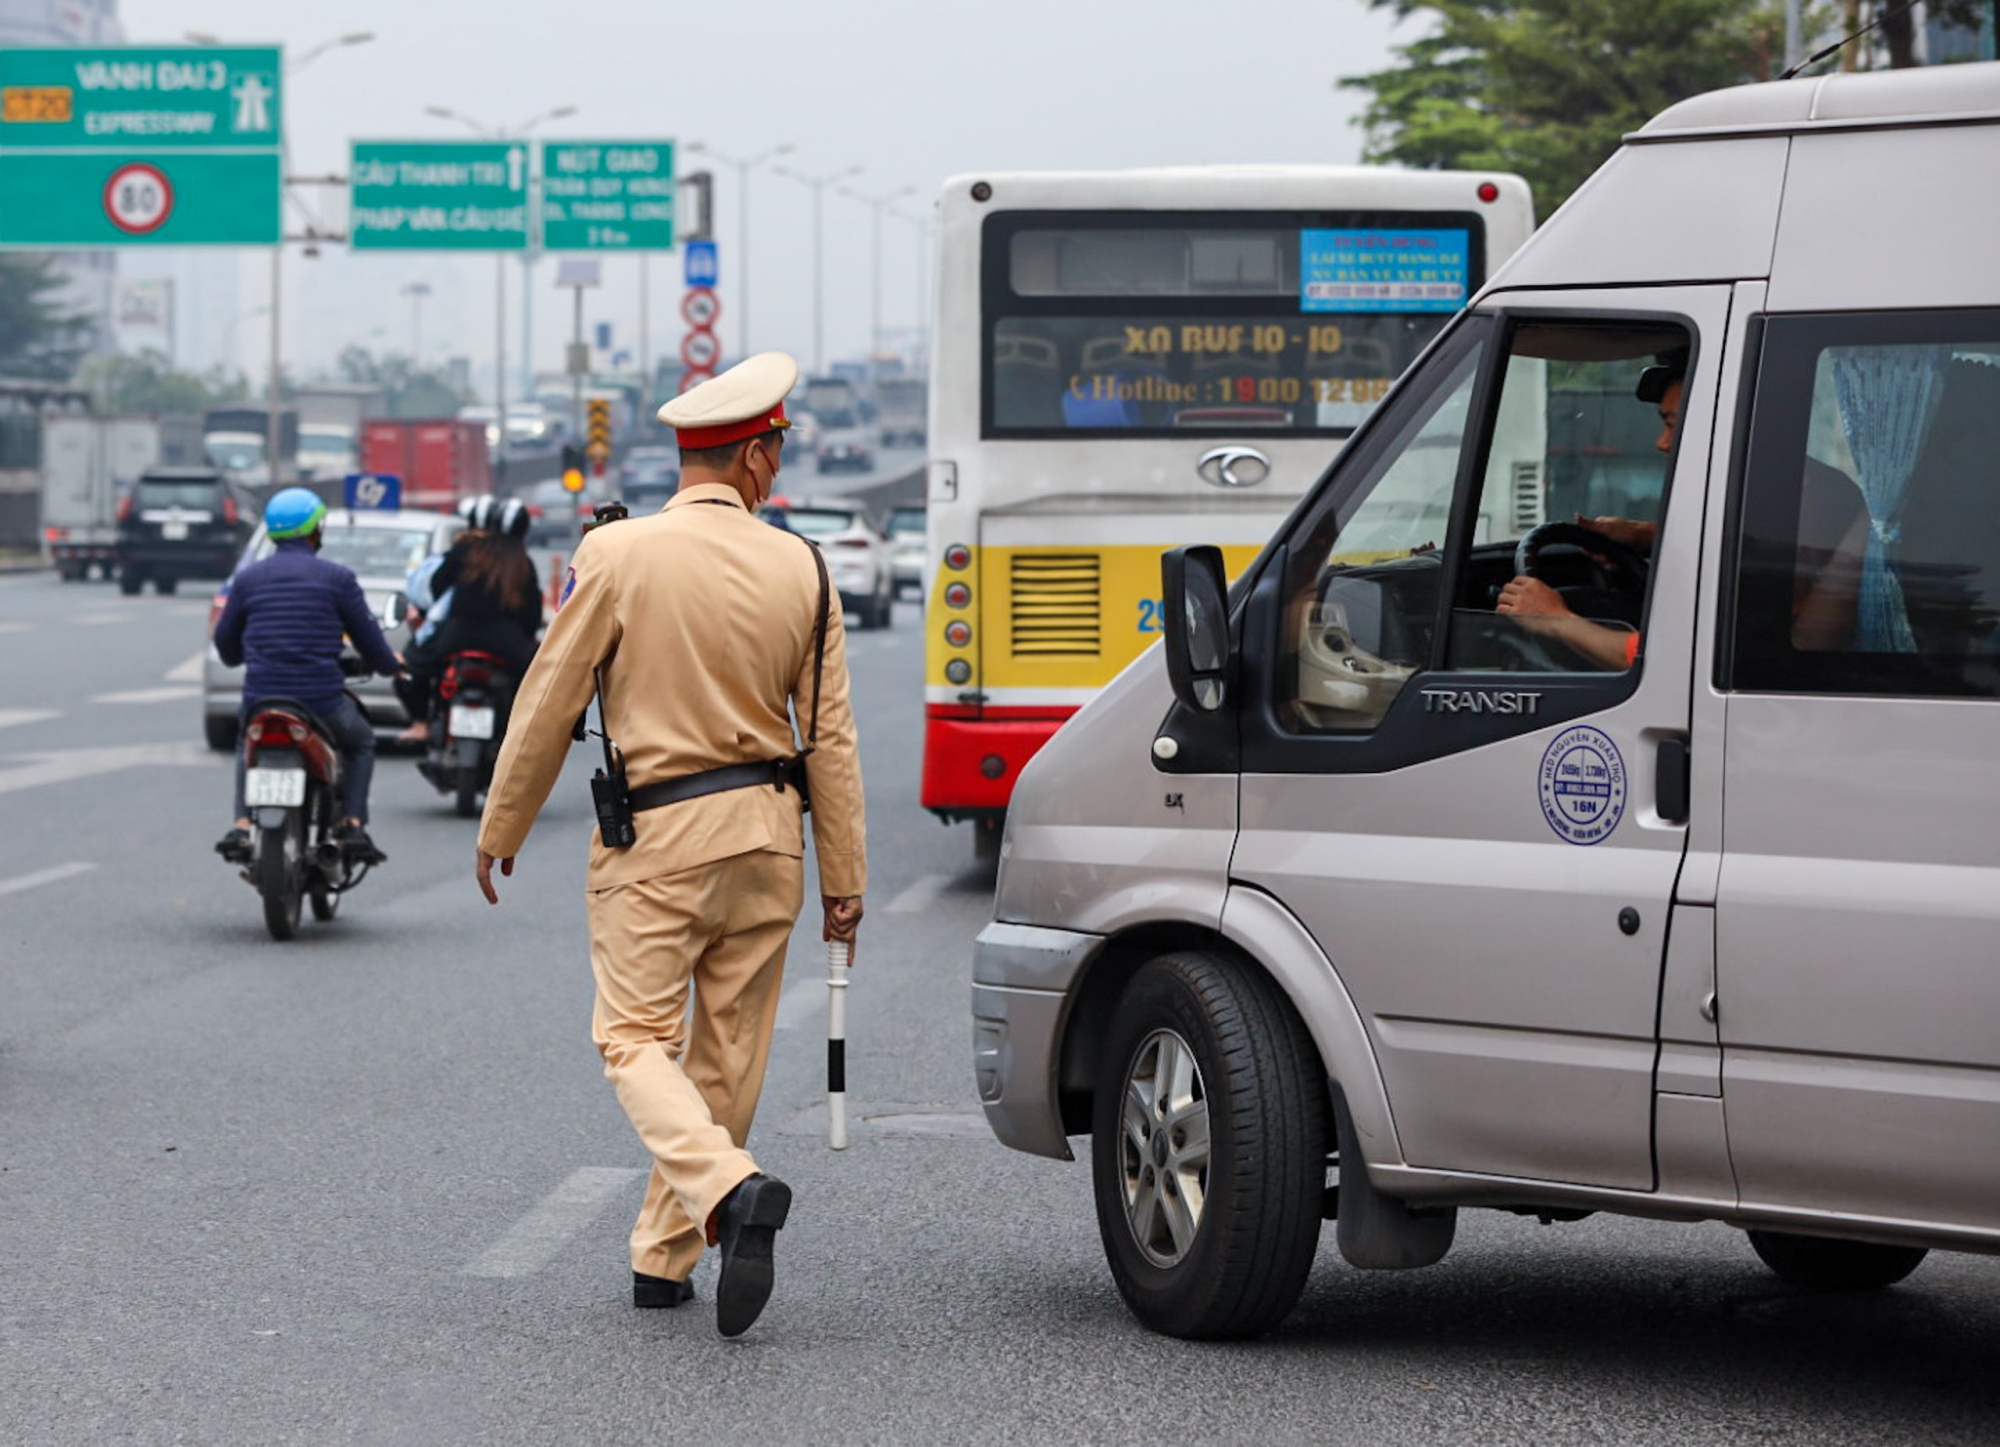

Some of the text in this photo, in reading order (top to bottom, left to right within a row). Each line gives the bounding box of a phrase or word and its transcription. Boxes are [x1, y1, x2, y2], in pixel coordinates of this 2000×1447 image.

[206, 61, 228, 91] 3
[84, 109, 217, 135] EXPRESSWAY
[121, 184, 156, 215] 80
[1181, 326, 1244, 352] BUS
[1420, 689, 1542, 715] TRANSIT
[1572, 800, 1597, 814] 16N
